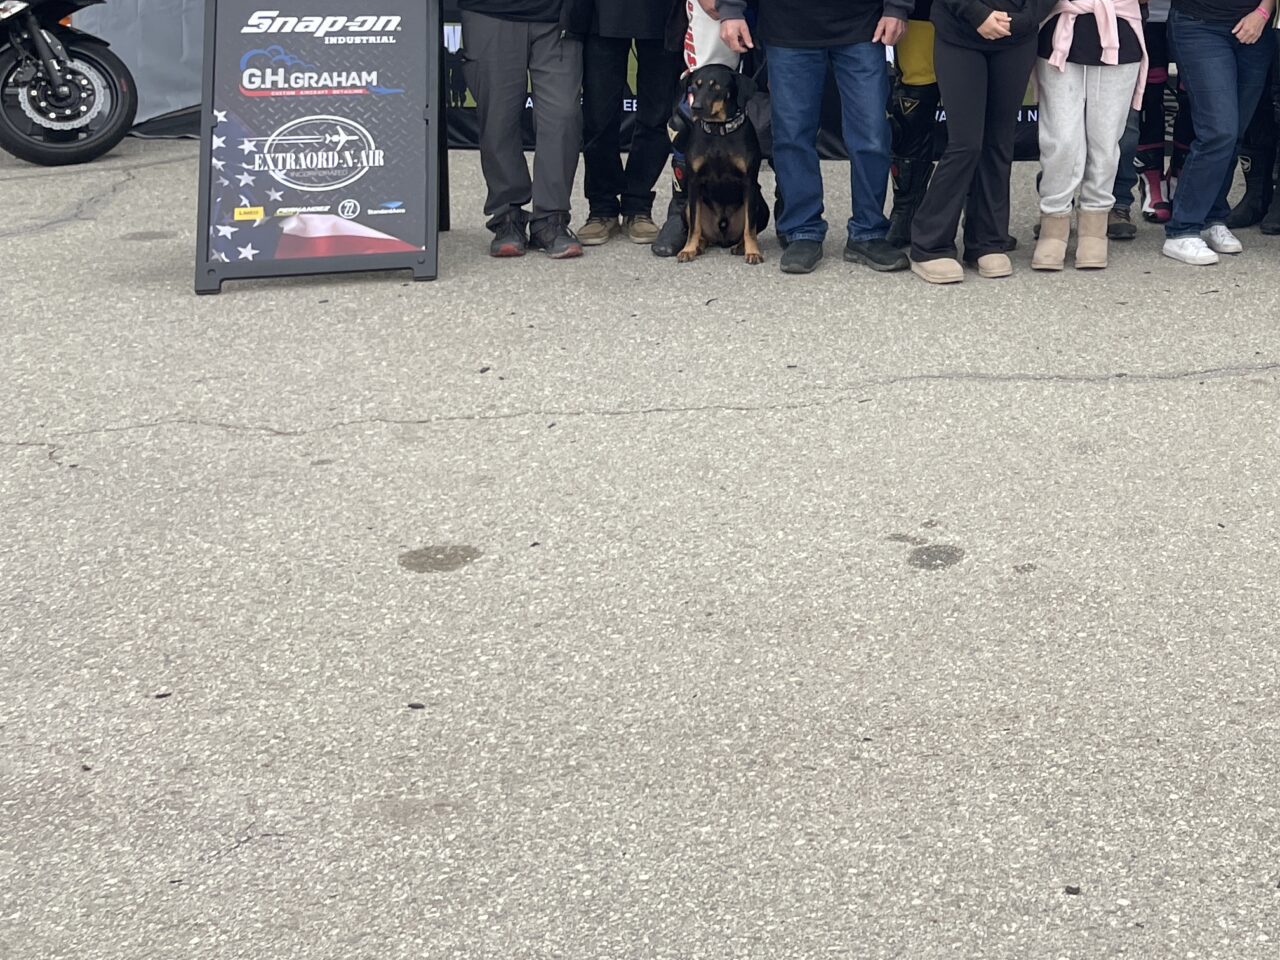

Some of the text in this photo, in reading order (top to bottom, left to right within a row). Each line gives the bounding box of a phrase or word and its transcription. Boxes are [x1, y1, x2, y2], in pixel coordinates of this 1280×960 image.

[241, 10, 401, 37] Snap-on
[324, 36, 396, 44] INDUSTRIAL
[290, 71, 377, 87] GRAHAM
[253, 149, 385, 171] EXTRAORD-N-AIR
[344, 202, 354, 215] 22
